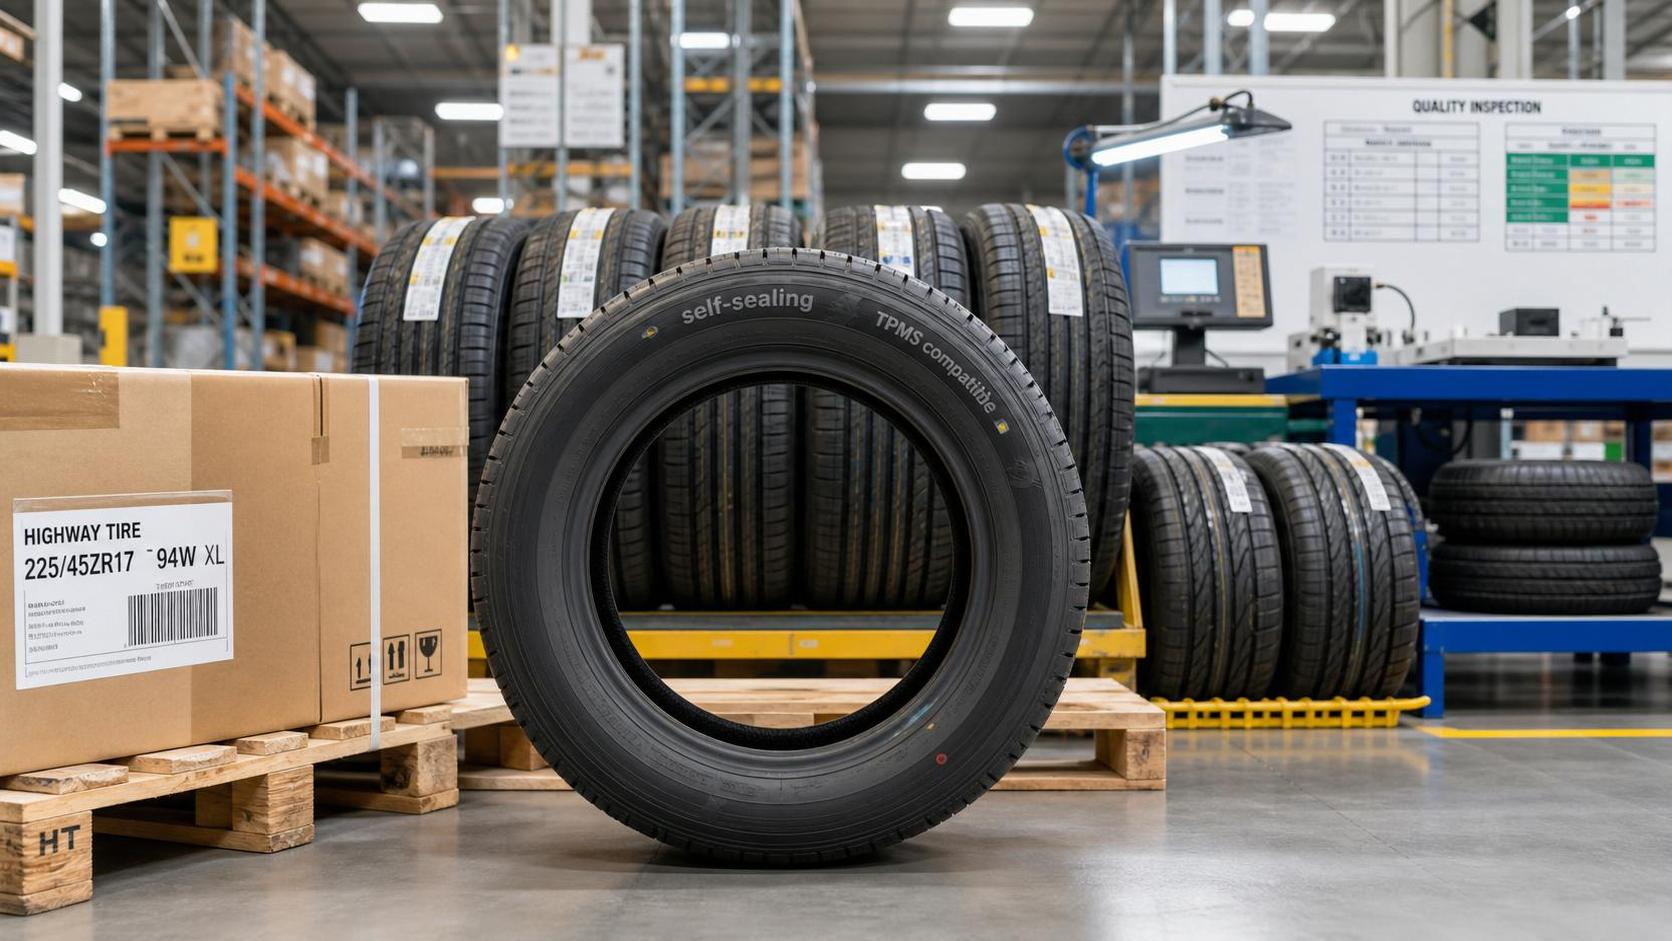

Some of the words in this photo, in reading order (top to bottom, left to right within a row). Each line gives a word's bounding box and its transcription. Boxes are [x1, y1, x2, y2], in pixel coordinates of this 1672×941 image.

[1413, 100, 1466, 113] QUALITY
[1471, 100, 1542, 114] INSPECTION
[681, 288, 814, 325] self-sealing
[875, 310, 925, 347] TPMS
[24, 522, 101, 546] HIGHWAY
[106, 521, 142, 541] TIRE
[24, 550, 135, 581] 225/45ZR17
[204, 544, 225, 566] XL
[39, 824, 81, 856] HT
